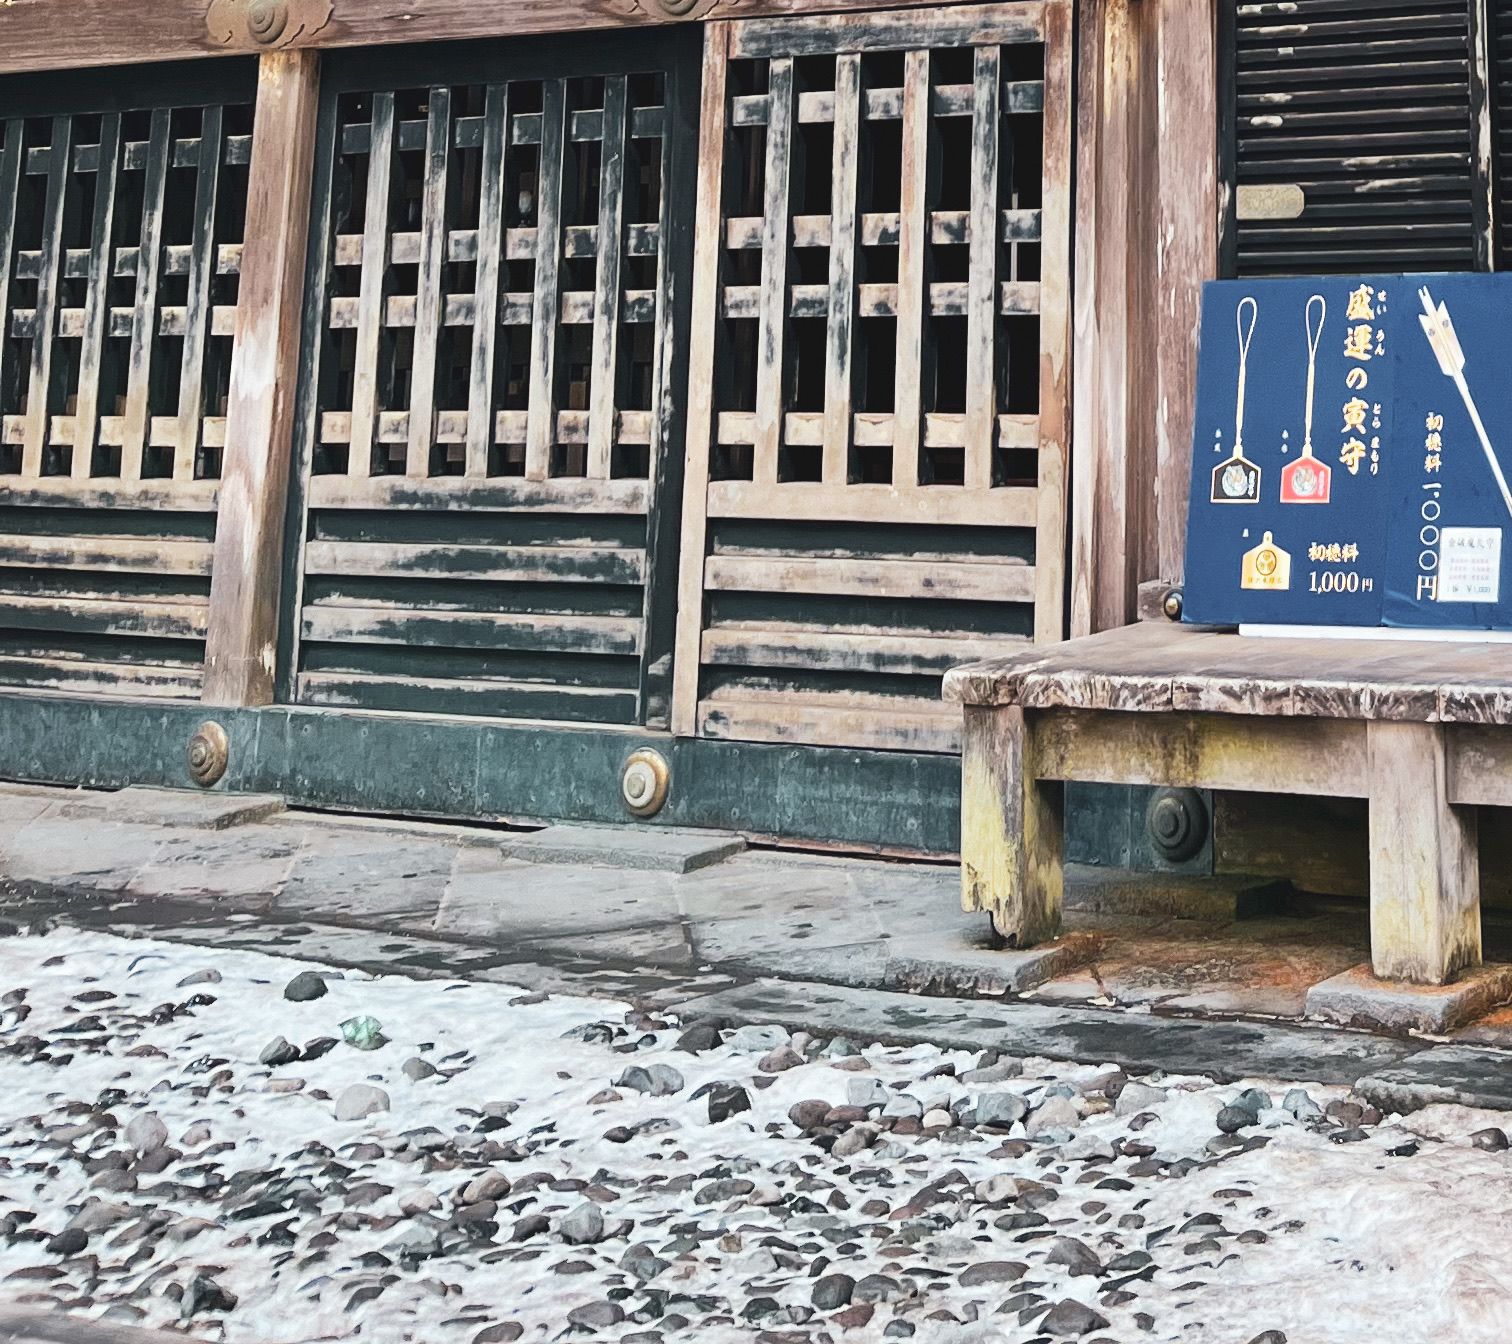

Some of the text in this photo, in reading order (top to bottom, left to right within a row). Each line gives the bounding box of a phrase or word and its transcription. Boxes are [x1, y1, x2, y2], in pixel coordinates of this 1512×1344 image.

[1338, 284, 1375, 476] 盛運の寅守
